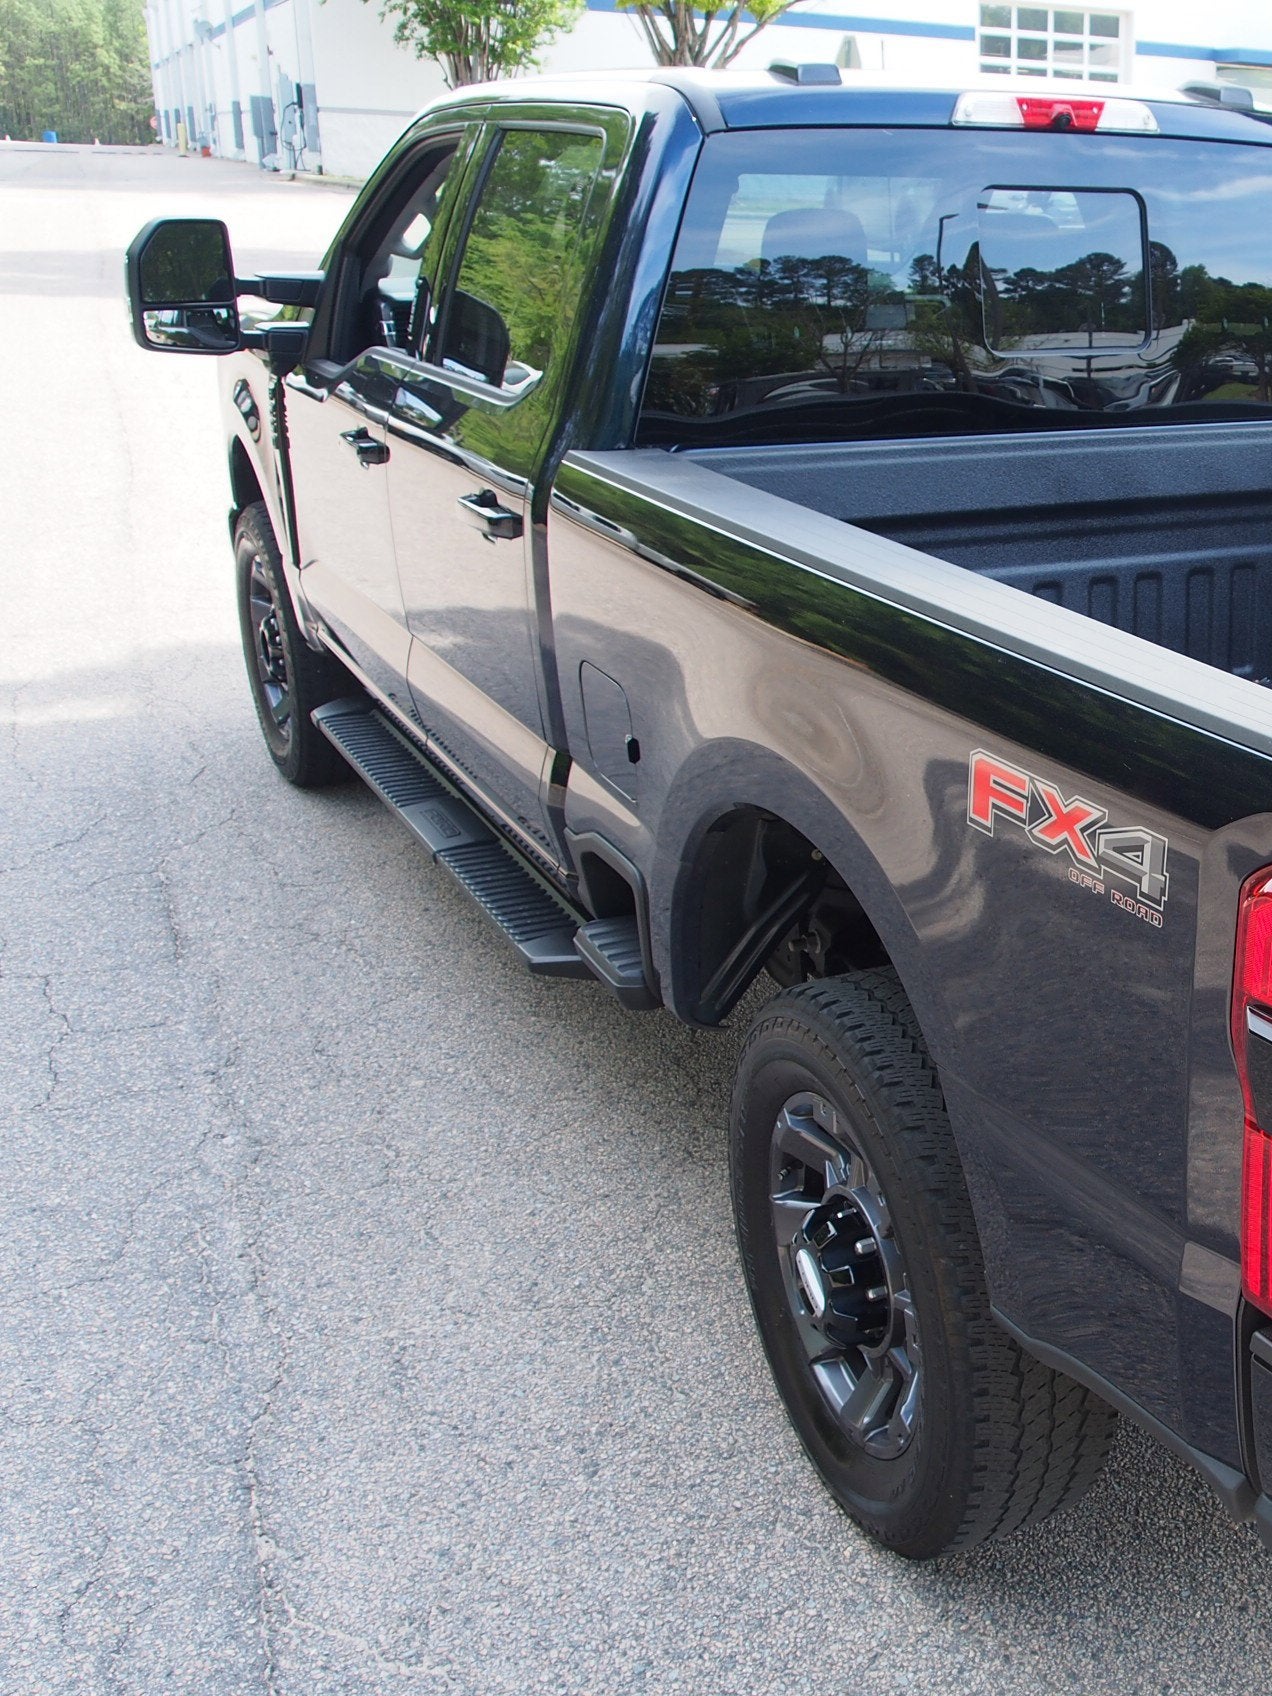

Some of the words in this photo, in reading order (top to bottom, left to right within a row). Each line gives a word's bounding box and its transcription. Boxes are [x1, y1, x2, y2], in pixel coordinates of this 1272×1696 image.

[967, 748, 1170, 911] FX4
[1068, 868, 1105, 895] OFF
[1110, 889, 1163, 928] ROAD
